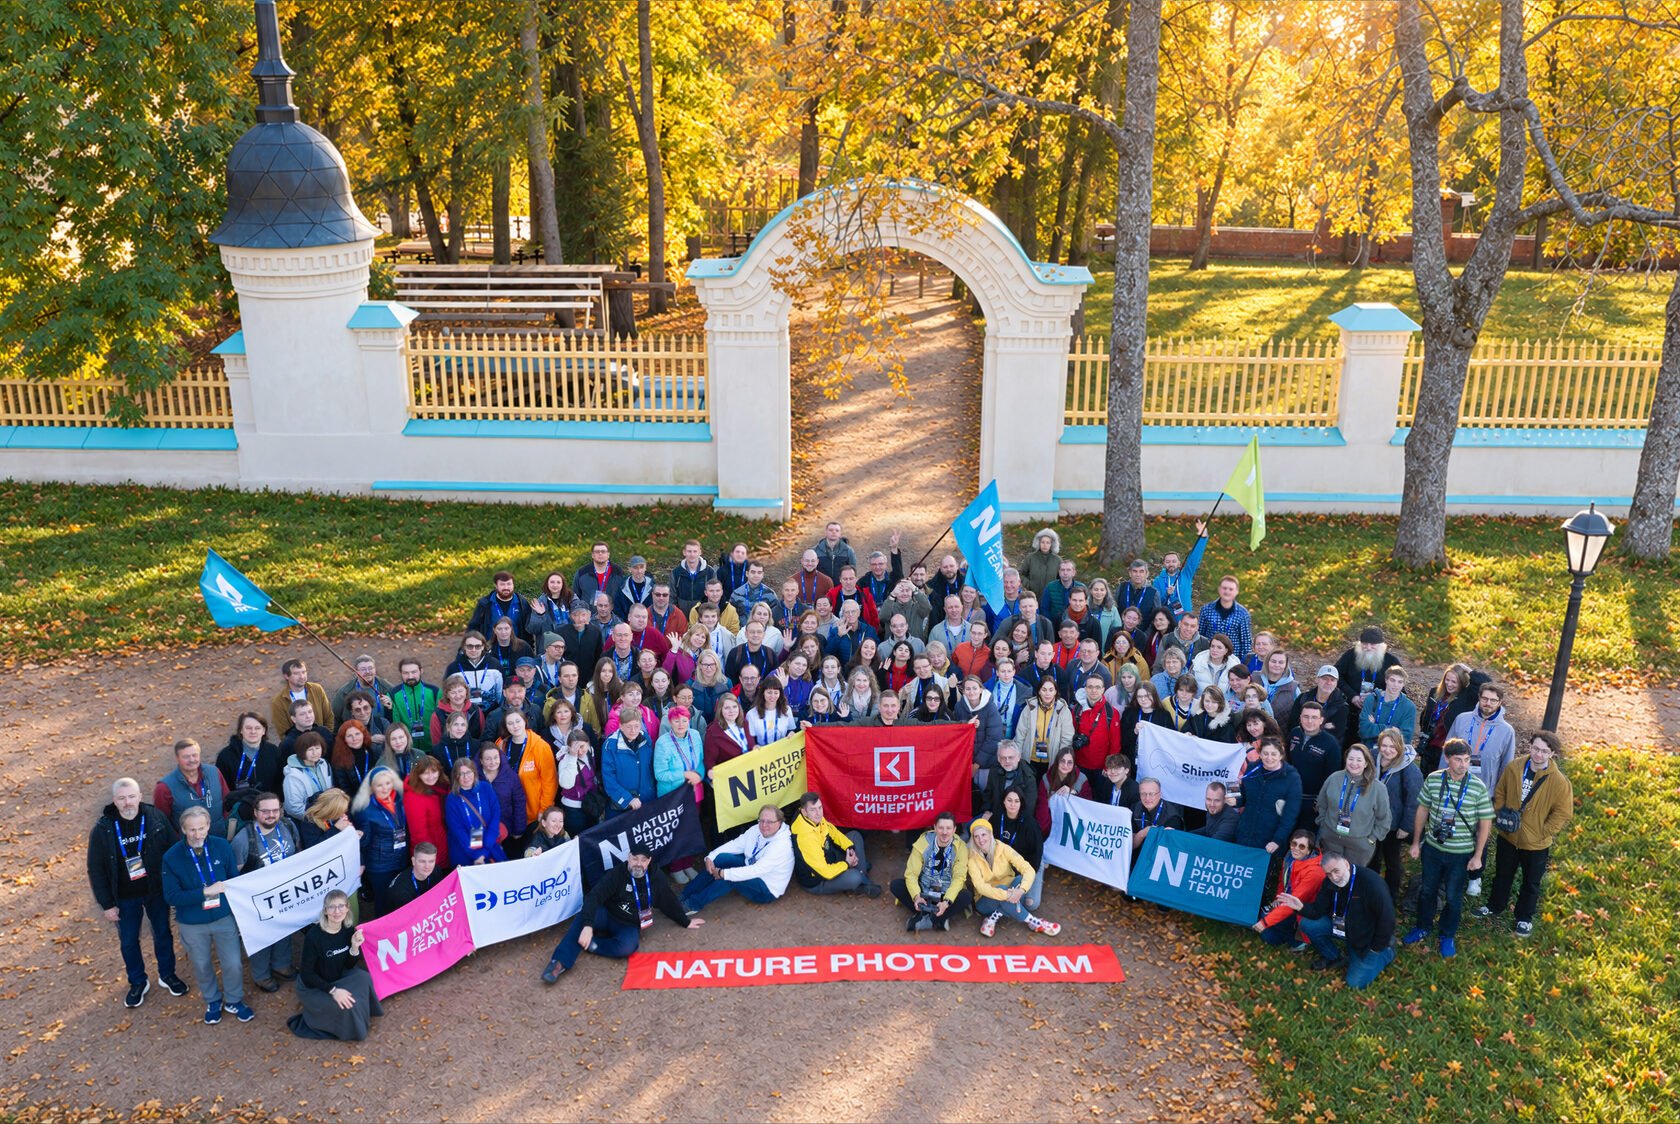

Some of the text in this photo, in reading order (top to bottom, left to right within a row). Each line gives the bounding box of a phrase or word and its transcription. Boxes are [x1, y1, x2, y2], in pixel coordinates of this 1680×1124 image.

[969, 504, 1001, 546] N
[1181, 763, 1230, 779] Shimoda
[728, 769, 758, 809] N
[762, 774, 794, 796] TEAM
[854, 798, 934, 814] СИНЕРГИЯ
[855, 790, 934, 803] УНИВЕРСИТЕТ
[632, 803, 685, 836] NATURE
[1087, 821, 1132, 839] NATURE
[634, 818, 680, 844] PHOTO
[645, 832, 673, 852] EAM
[1059, 812, 1085, 851] N
[1087, 833, 1123, 849] PHOTO
[598, 831, 631, 871] N
[1084, 843, 1114, 861] TEAM
[1149, 846, 1189, 888] N
[1194, 857, 1254, 879] NATURE
[263, 868, 339, 909] TENBA
[504, 870, 568, 905] BENRO
[1191, 868, 1243, 889] PHOTO
[554, 885, 571, 901] go!
[1188, 880, 1230, 900] TEAM
[279, 904, 295, 914] NEW
[297, 894, 314, 906] YORK
[377, 931, 408, 971] N
[411, 928, 449, 957] TEAM
[654, 952, 1093, 980] NATURE PHOTO TEAM
